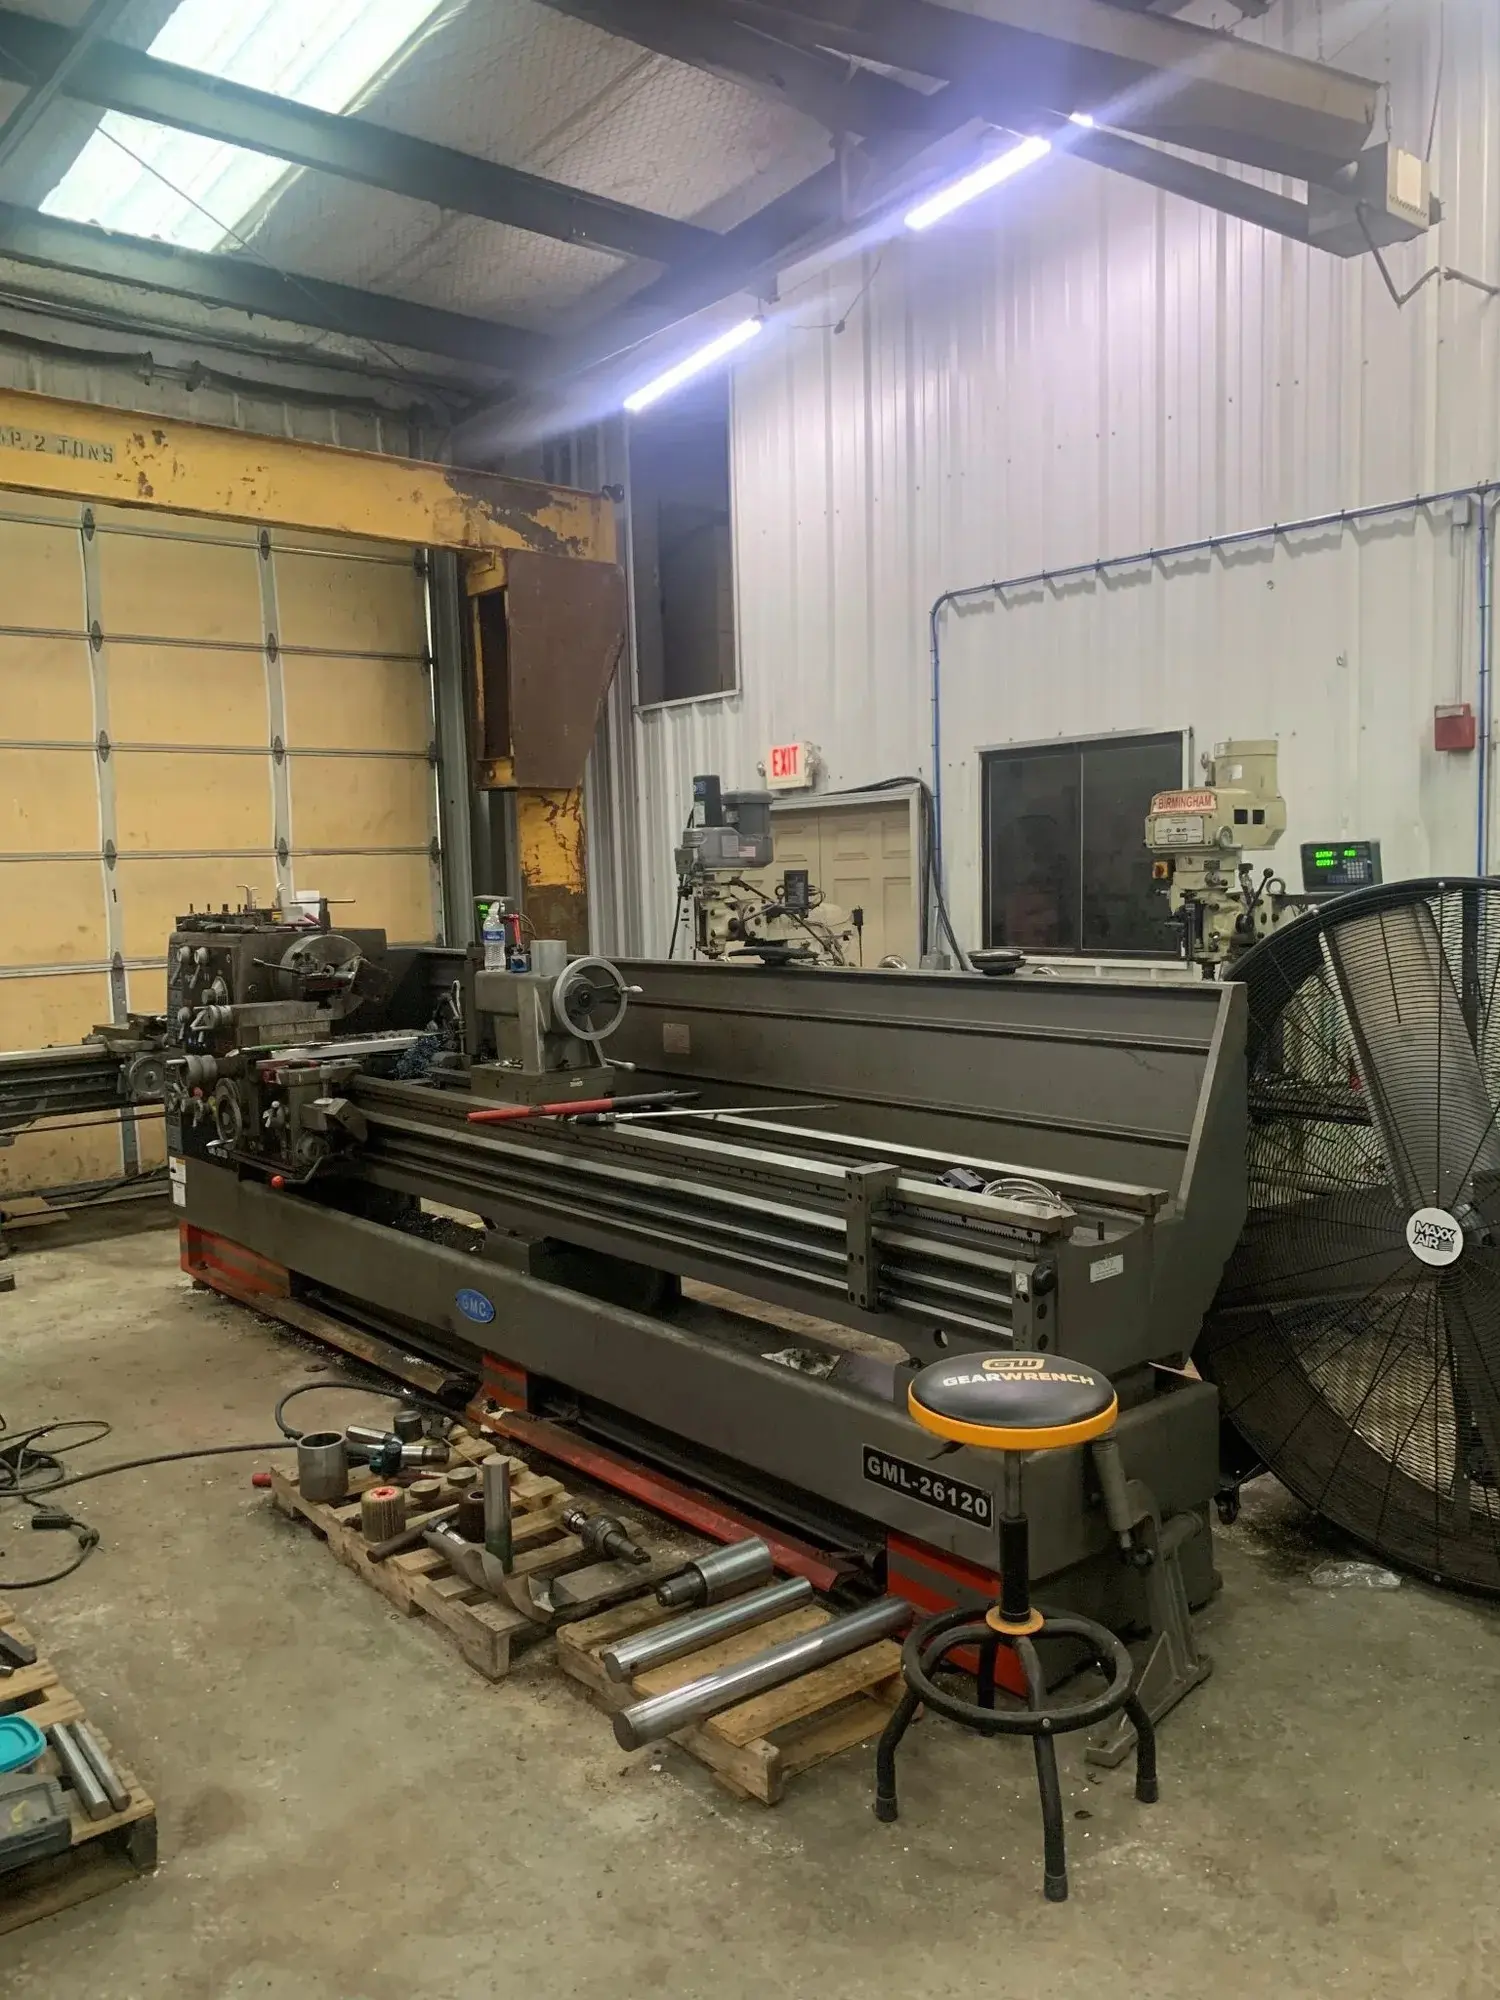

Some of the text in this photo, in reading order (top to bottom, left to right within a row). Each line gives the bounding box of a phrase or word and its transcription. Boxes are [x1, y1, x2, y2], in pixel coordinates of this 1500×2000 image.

[34, 434, 46, 452] 2
[57, 438, 114, 464] TONS
[772, 746, 798, 777] EXIT
[1158, 794, 1212, 810] BIRMINGHAM
[1413, 1233, 1440, 1250] AIR
[986, 1358, 1041, 1369] GW
[943, 1372, 1096, 1387] GEARWRENCH
[867, 1456, 988, 1518] GML-26120
